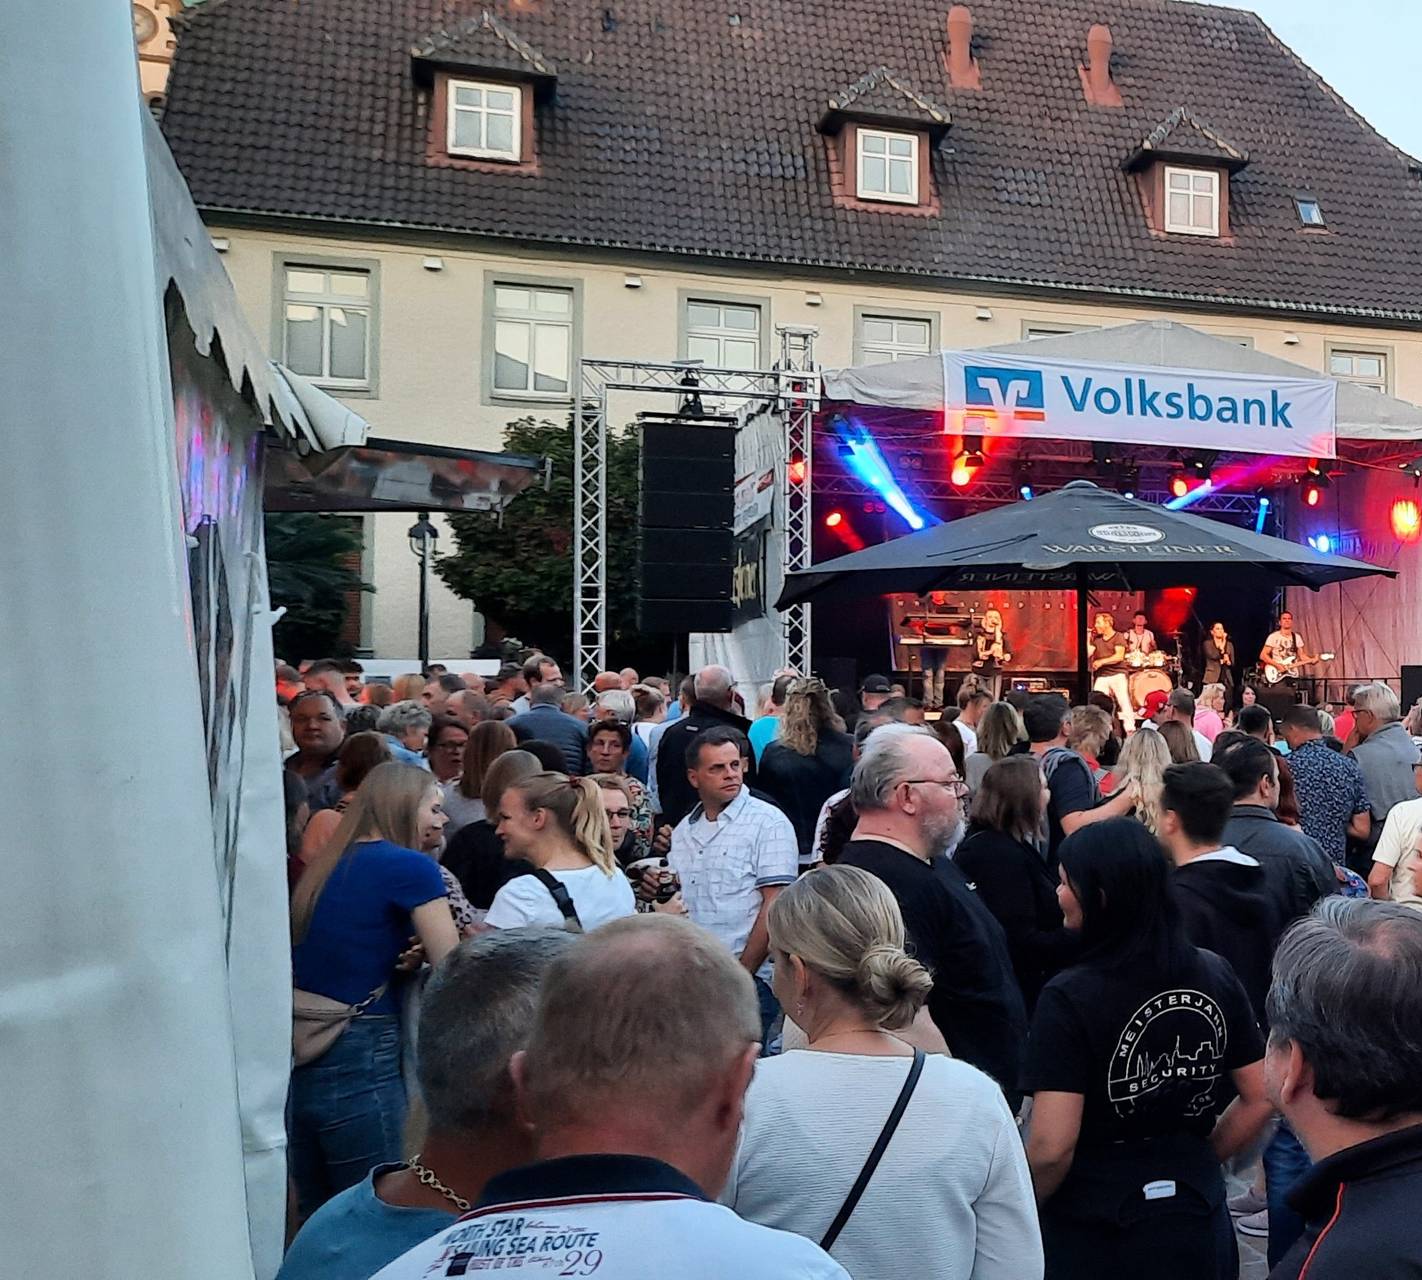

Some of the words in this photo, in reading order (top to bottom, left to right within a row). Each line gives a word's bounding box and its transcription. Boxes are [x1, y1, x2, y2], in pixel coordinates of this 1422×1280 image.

[1060, 375, 1294, 429] Volksbank
[1128, 1063, 1217, 1093] SECURITY
[486, 1217, 526, 1238] STAR
[506, 1236, 538, 1256] SEA
[539, 1232, 600, 1252] ROUTE
[558, 1249, 603, 1276] 29
